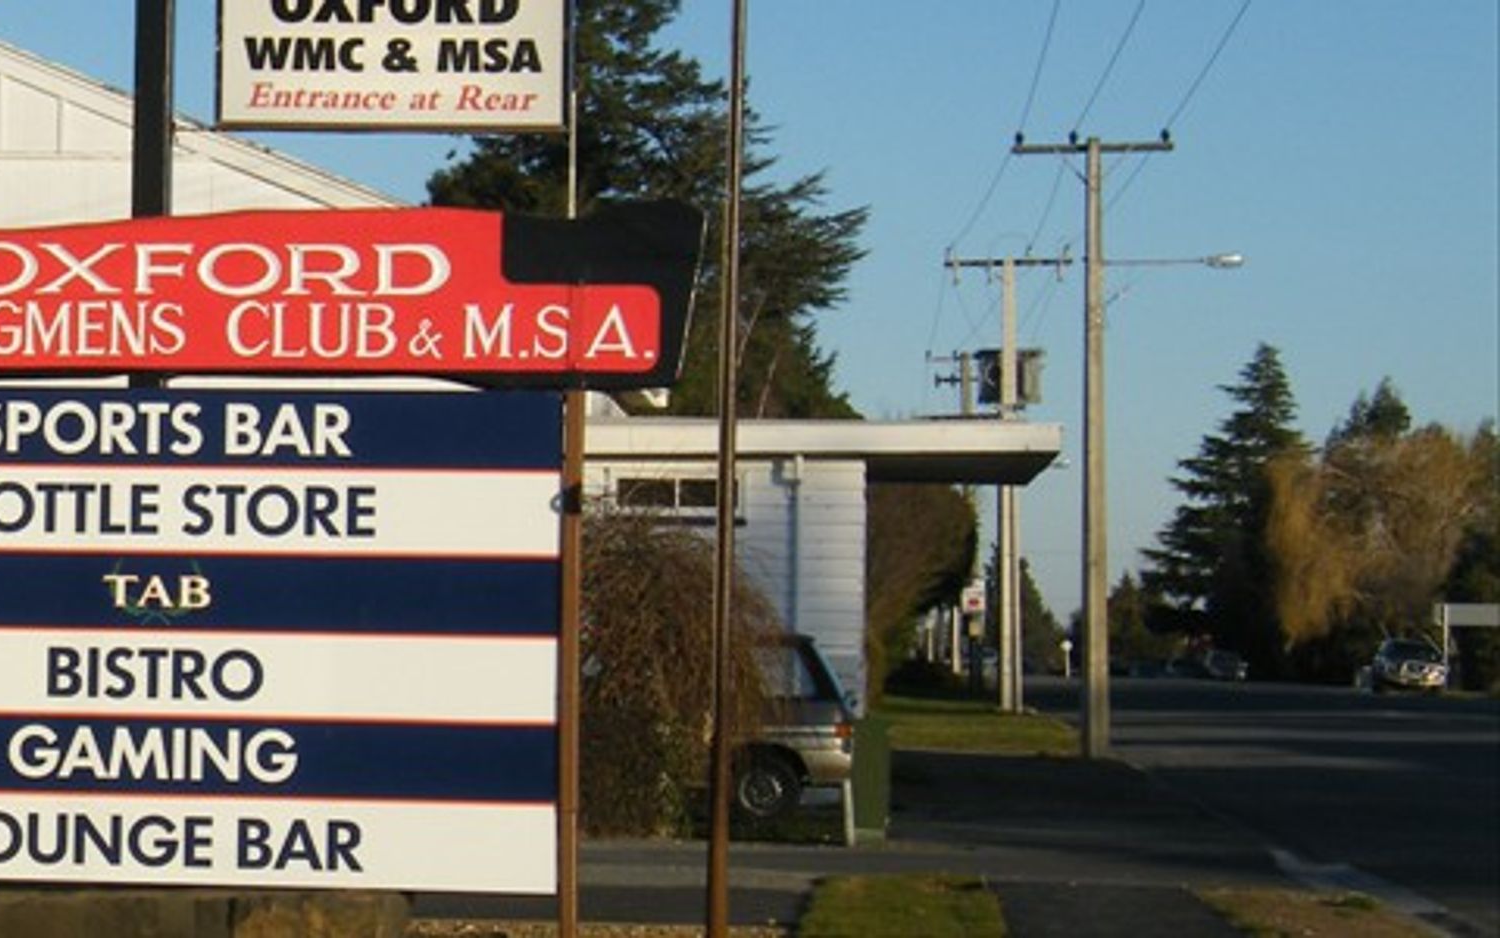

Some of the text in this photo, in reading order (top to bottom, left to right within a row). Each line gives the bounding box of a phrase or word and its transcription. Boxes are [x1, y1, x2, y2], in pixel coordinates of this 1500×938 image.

[271, 0, 520, 23] OXFORD
[245, 37, 542, 73] WMC & MSA
[248, 82, 537, 111] Entrance at Rear
[226, 299, 397, 358] CLUB
[408, 318, 443, 360] &
[463, 303, 656, 359] M.SA.
[224, 402, 353, 457] BAR
[181, 484, 377, 538] STORE
[103, 574, 212, 610] TAB
[45, 646, 265, 702] BISTRO
[8, 724, 299, 783] GAMING
[235, 817, 364, 872] BAR
